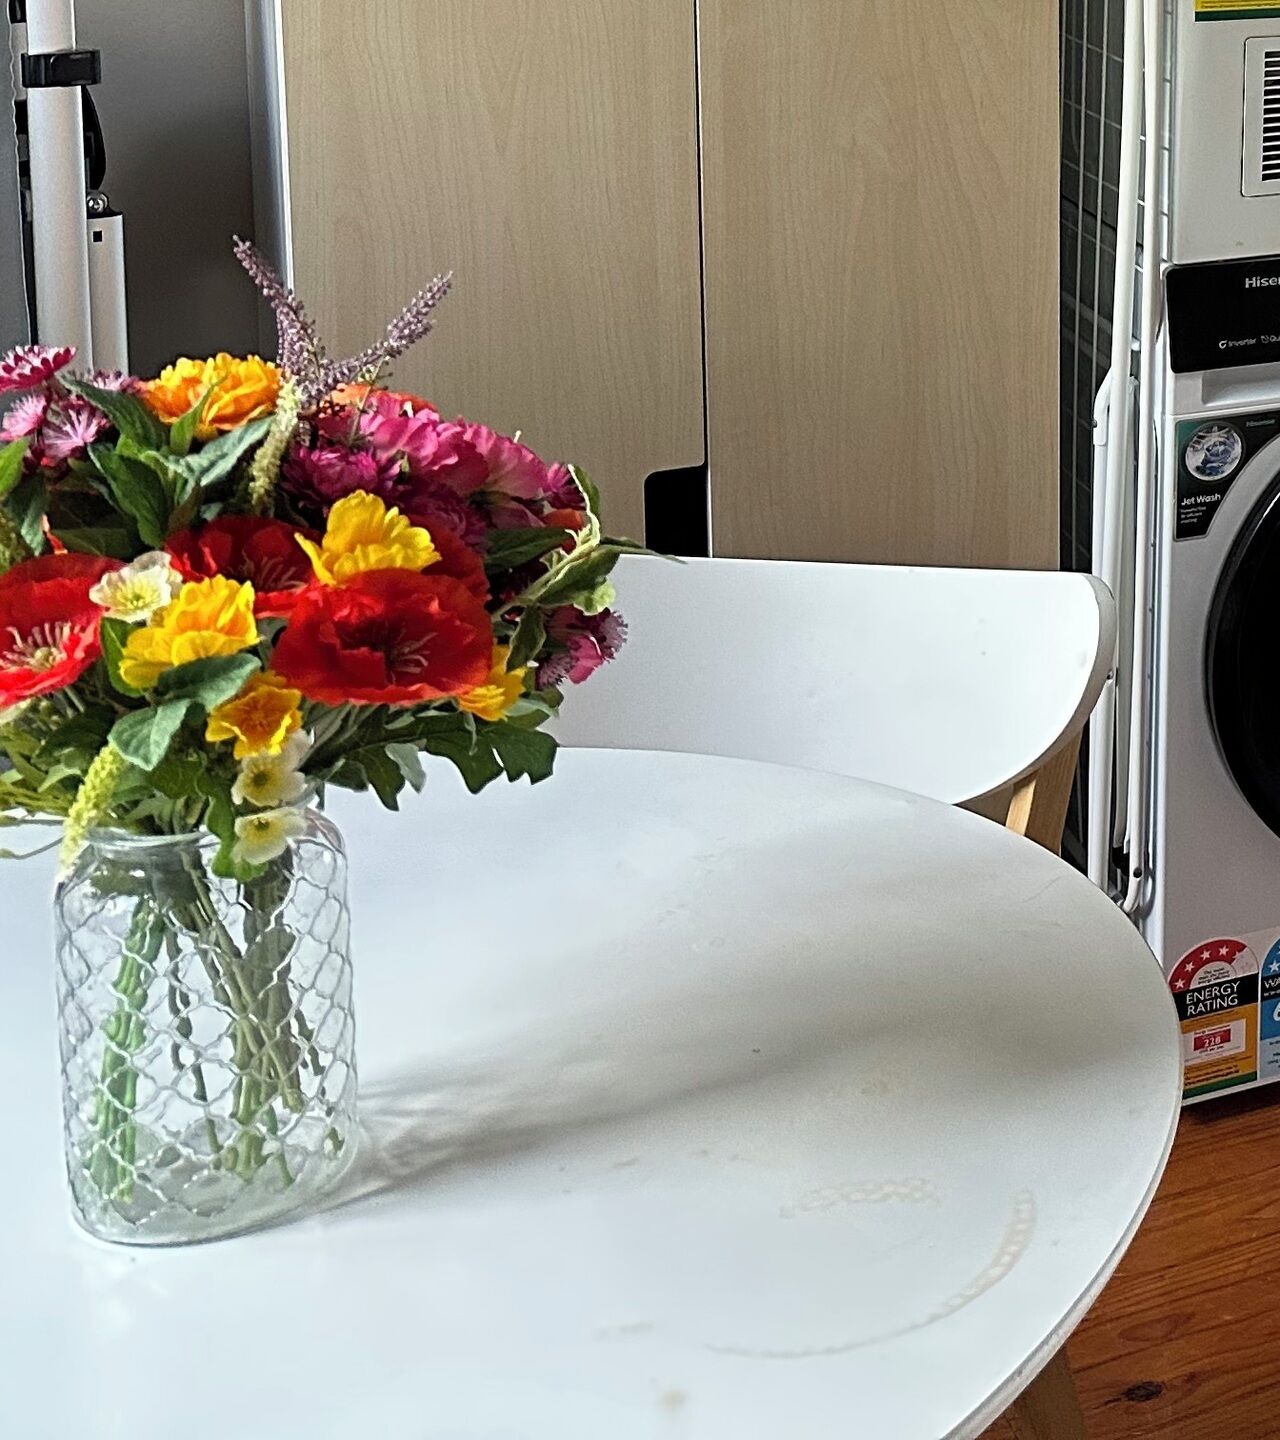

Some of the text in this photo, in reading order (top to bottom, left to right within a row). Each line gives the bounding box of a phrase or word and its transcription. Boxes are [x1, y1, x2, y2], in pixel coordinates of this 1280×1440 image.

[1181, 493, 1221, 506] Jet Wash
[1186, 981, 1240, 1005] ENERGY
[1187, 994, 1238, 1017] RATING
